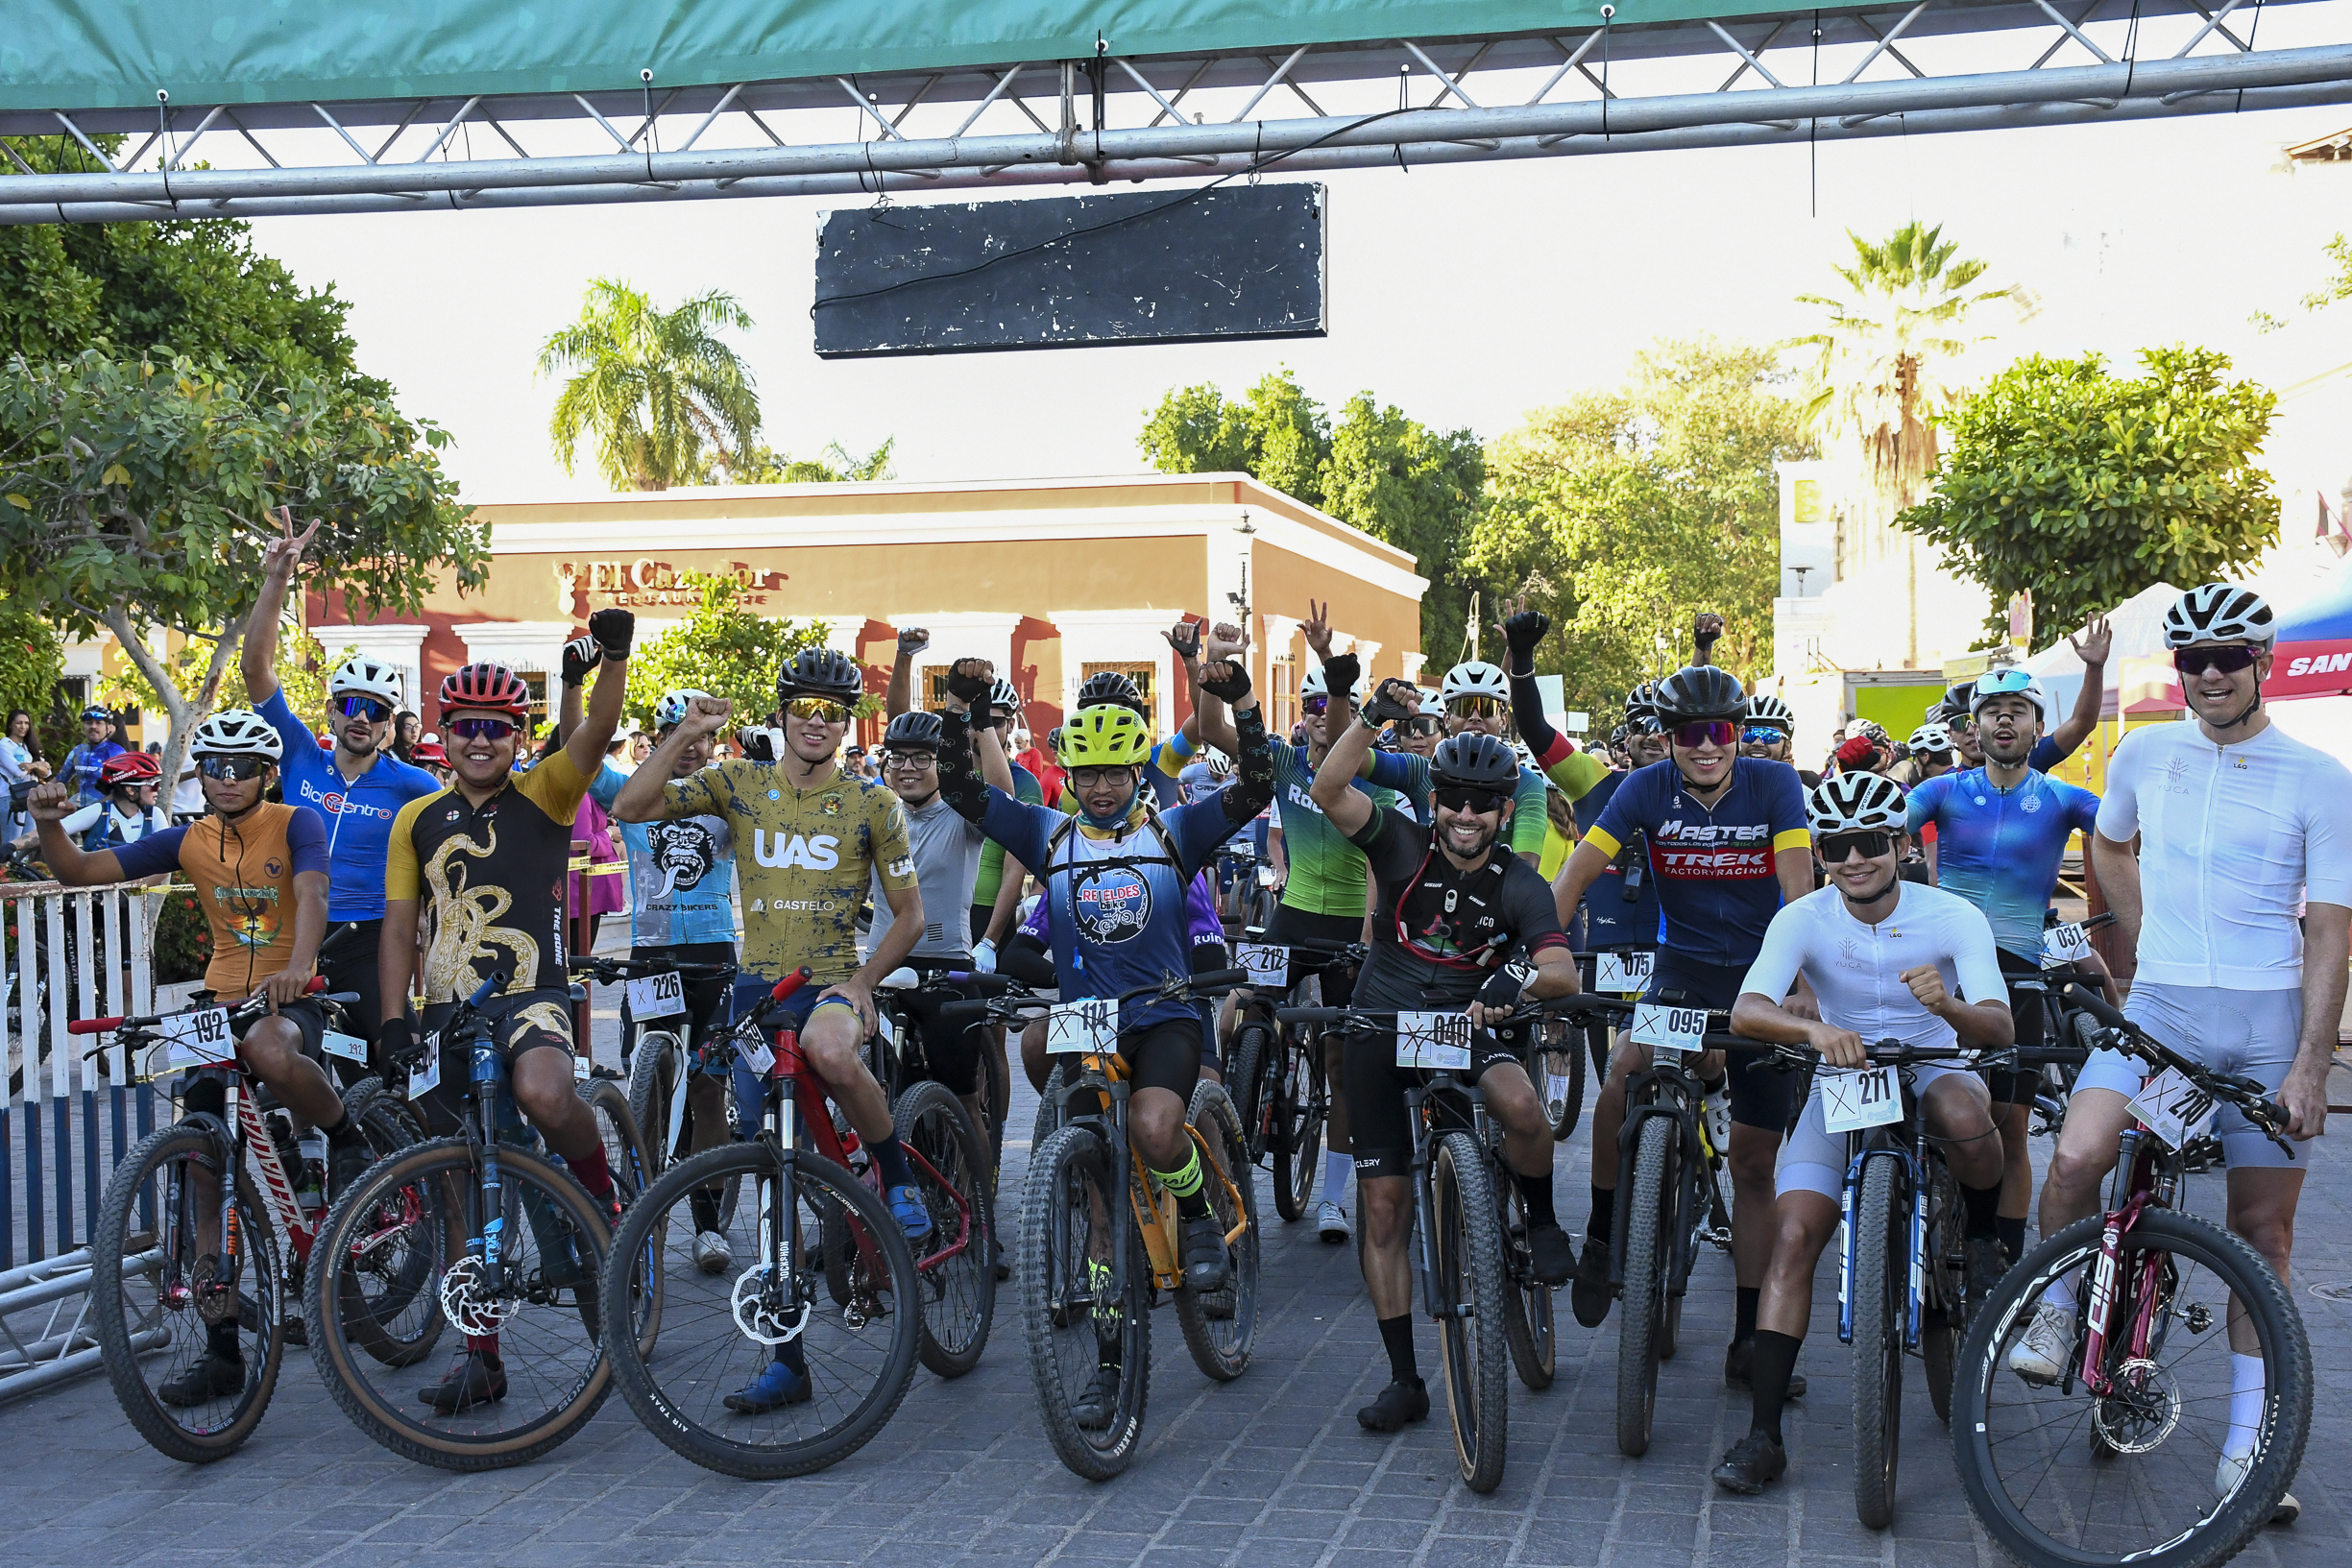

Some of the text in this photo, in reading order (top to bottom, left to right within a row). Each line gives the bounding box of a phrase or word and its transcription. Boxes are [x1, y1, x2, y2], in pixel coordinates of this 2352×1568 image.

[587, 561, 625, 591] El
[2157, 784, 2190, 795] YUCA
[1657, 819, 1769, 840] MASTER
[754, 829, 839, 871] UAS
[1661, 852, 1767, 868] TREK
[1664, 866, 1767, 876] FACTORY RACING
[773, 900, 835, 911] GASTELO
[2055, 925, 2083, 949] 031
[1260, 946, 1284, 970] 212
[652, 974, 680, 1001] 226
[192, 1010, 226, 1044] 192
[1080, 1001, 1109, 1031] 114
[1433, 1014, 1468, 1048] 040
[1668, 1009, 1705, 1036] 095
[348, 1042, 364, 1056] 192
[1857, 1069, 1891, 1105] 271
[485, 1232, 502, 1265] FOX
[648, 1392, 689, 1433] AIR TRAK
[2269, 1394, 2280, 1427] FAST
[1113, 1415, 1137, 1457] MAXXIS
[2257, 1430, 2274, 1464] TRAK
